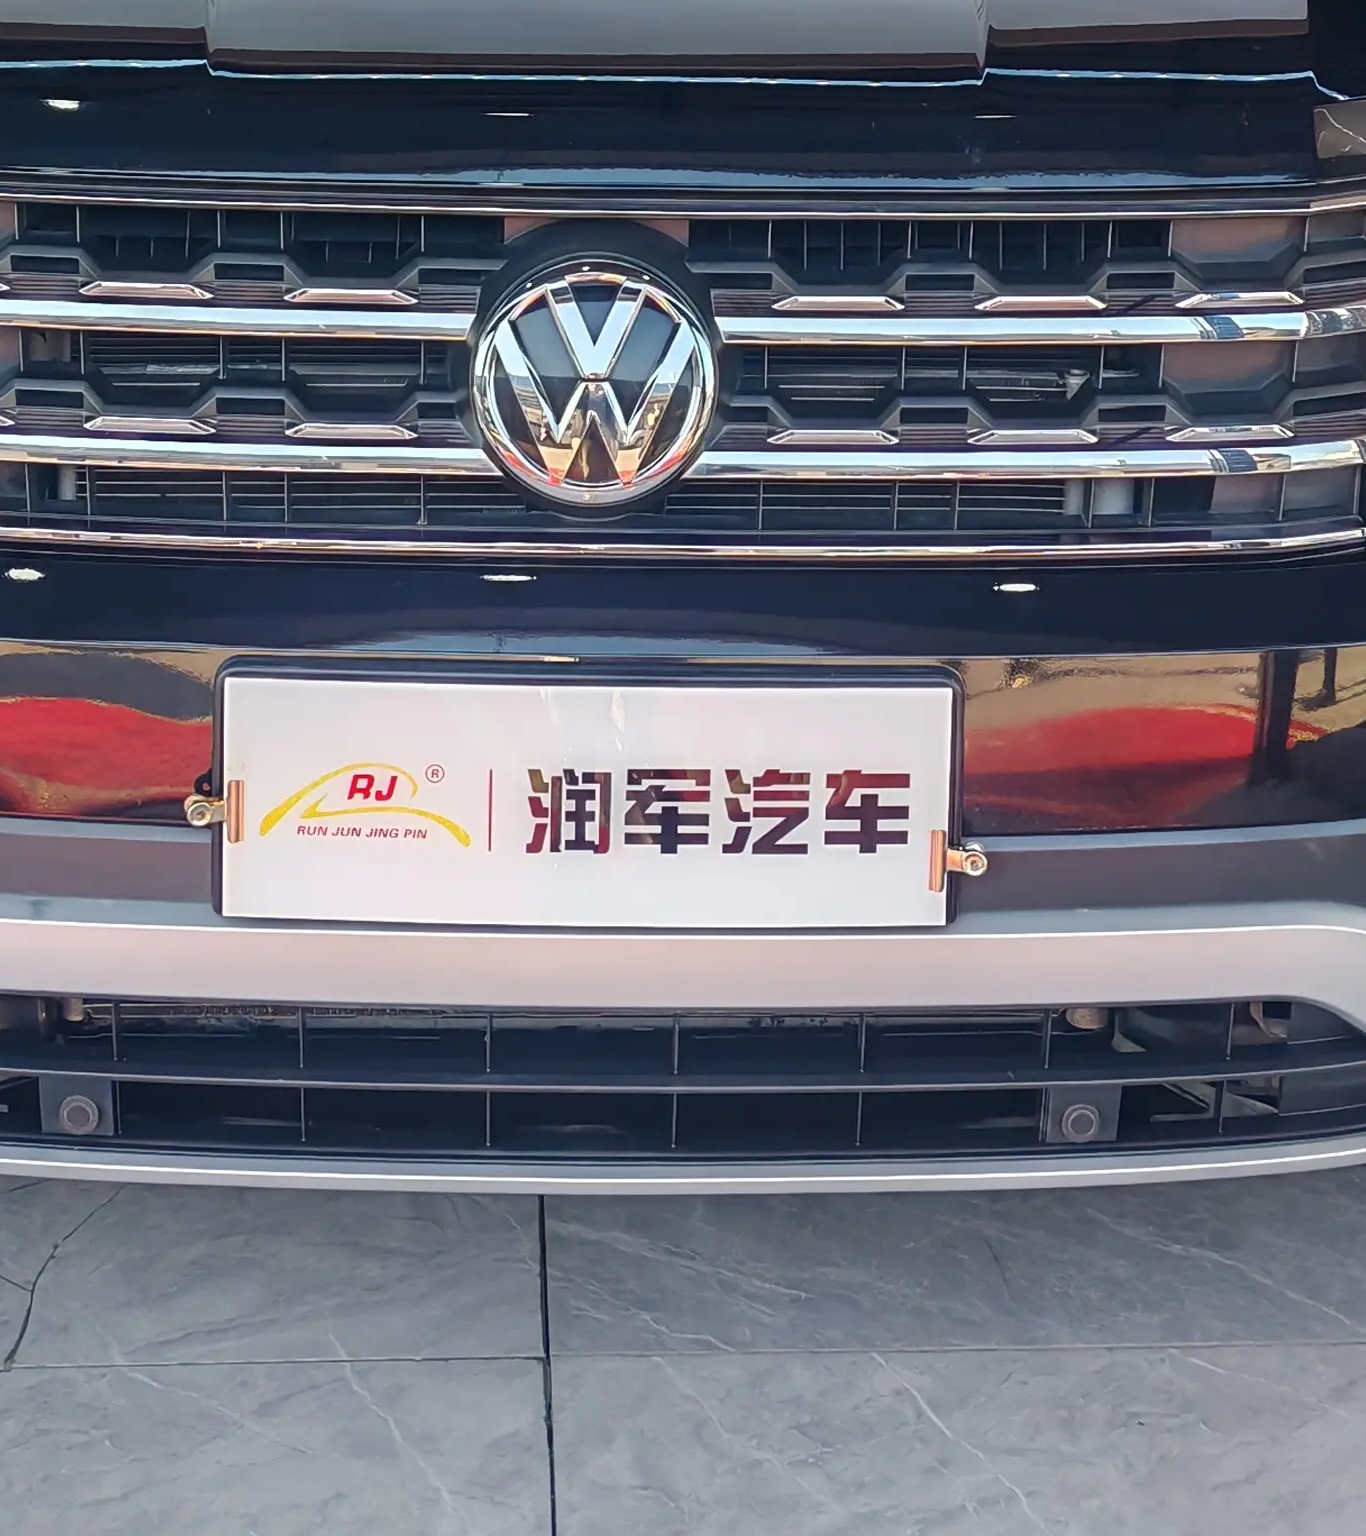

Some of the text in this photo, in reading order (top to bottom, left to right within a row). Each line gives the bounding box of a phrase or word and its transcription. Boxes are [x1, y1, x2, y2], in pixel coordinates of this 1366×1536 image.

[347, 773, 398, 802] RJ
[525, 768, 910, 856] 润军汽车
[296, 825, 428, 840] RUN JUN JING PIN
